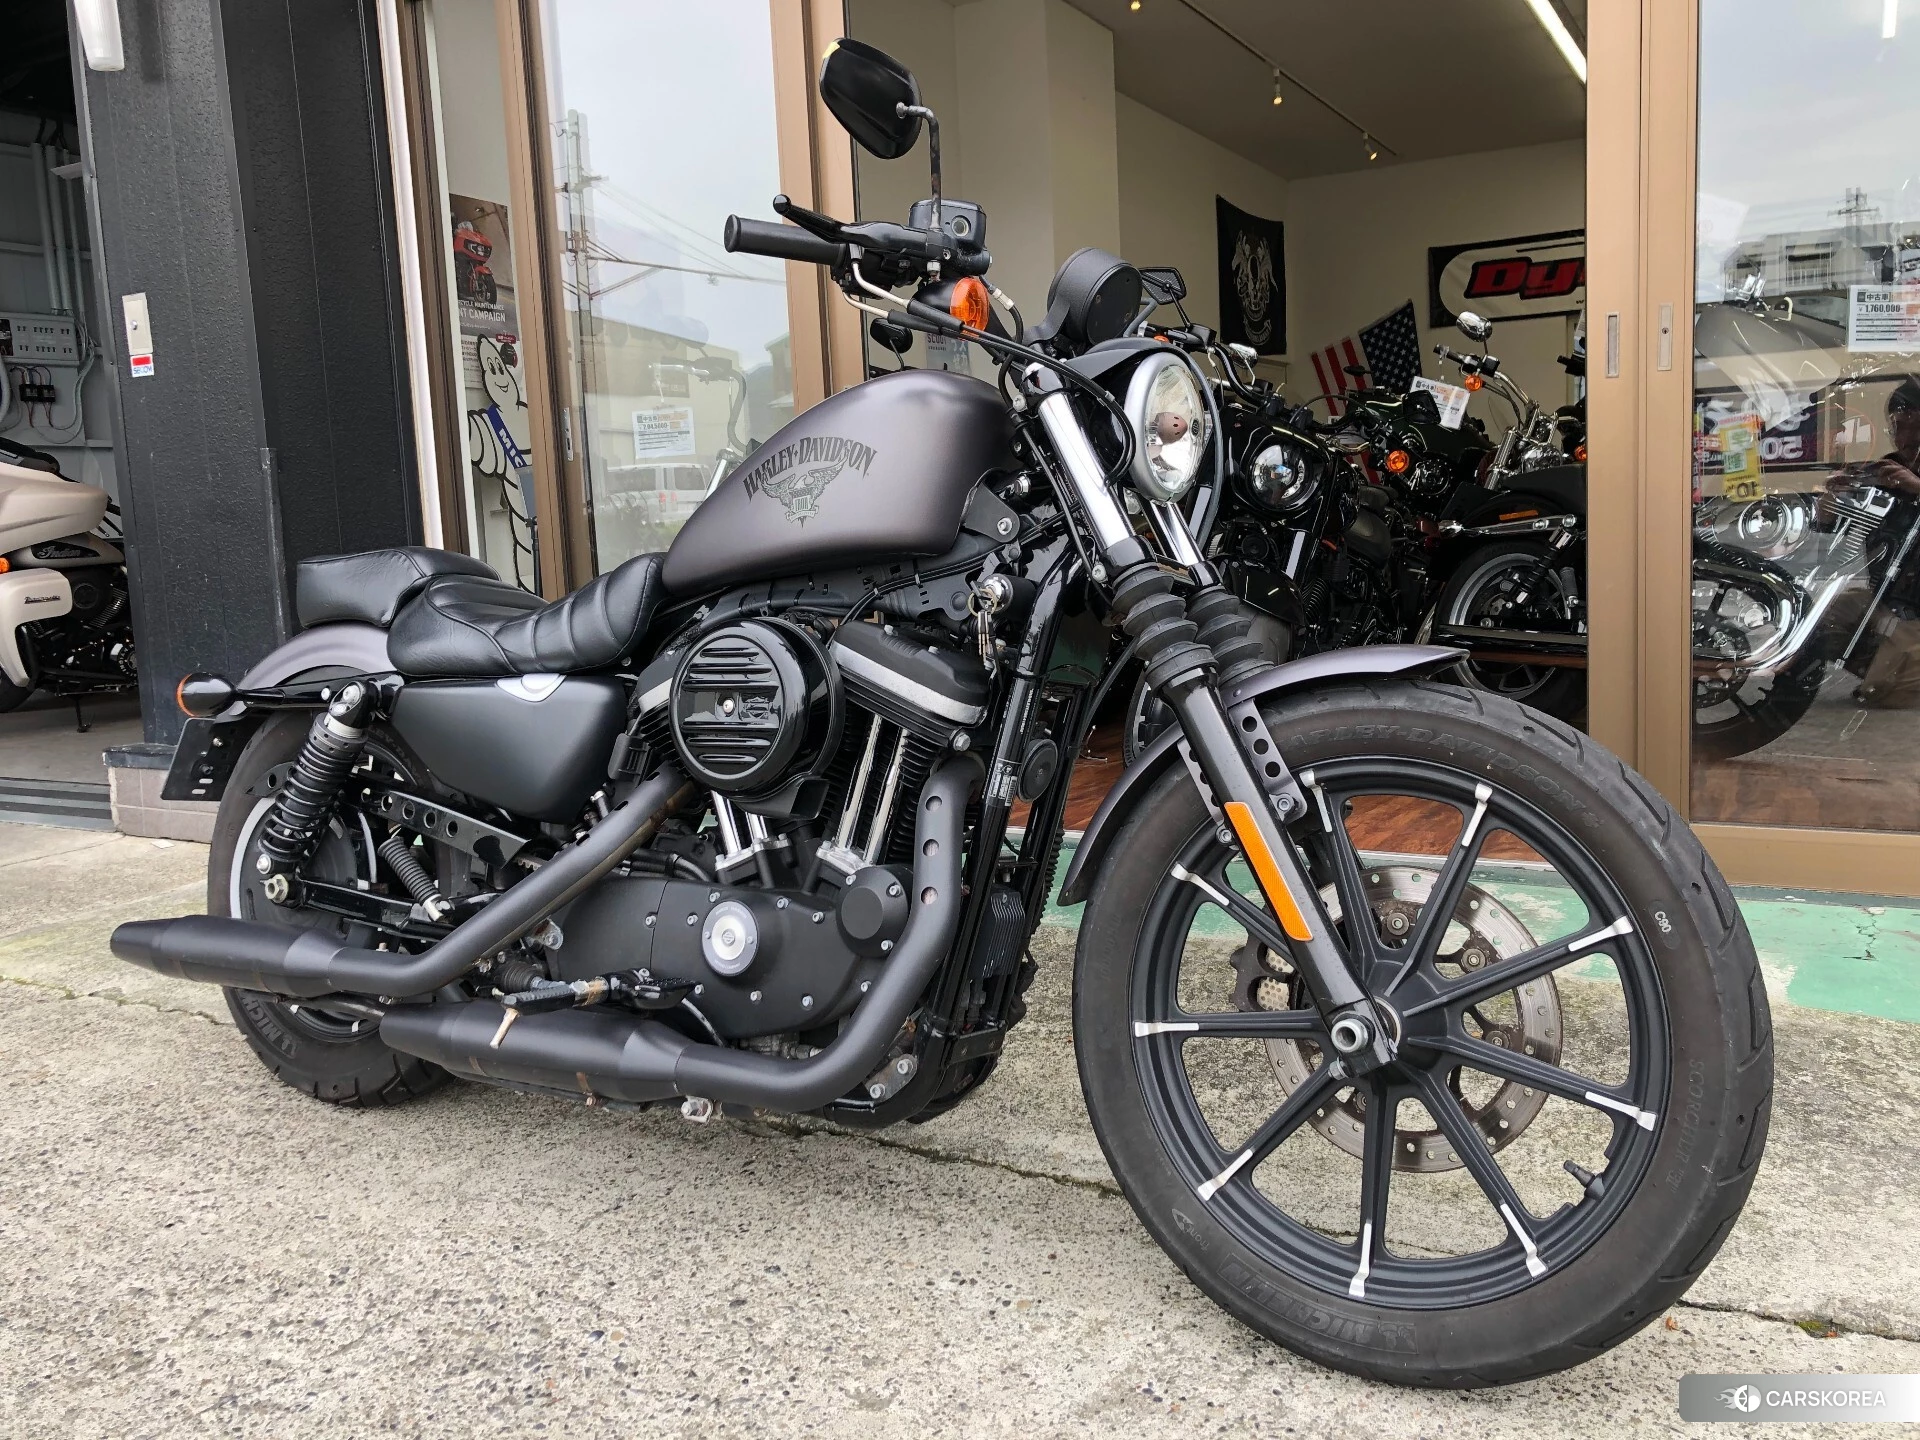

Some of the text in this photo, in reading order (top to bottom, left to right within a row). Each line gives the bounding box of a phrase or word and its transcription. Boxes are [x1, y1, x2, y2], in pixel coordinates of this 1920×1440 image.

[1466, 258, 1585, 300] Dy
[469, 309, 506, 322] CAMPAIGN
[38, 545, 81, 558] Indian
[1219, 1262, 1377, 1345] MICHELIN
